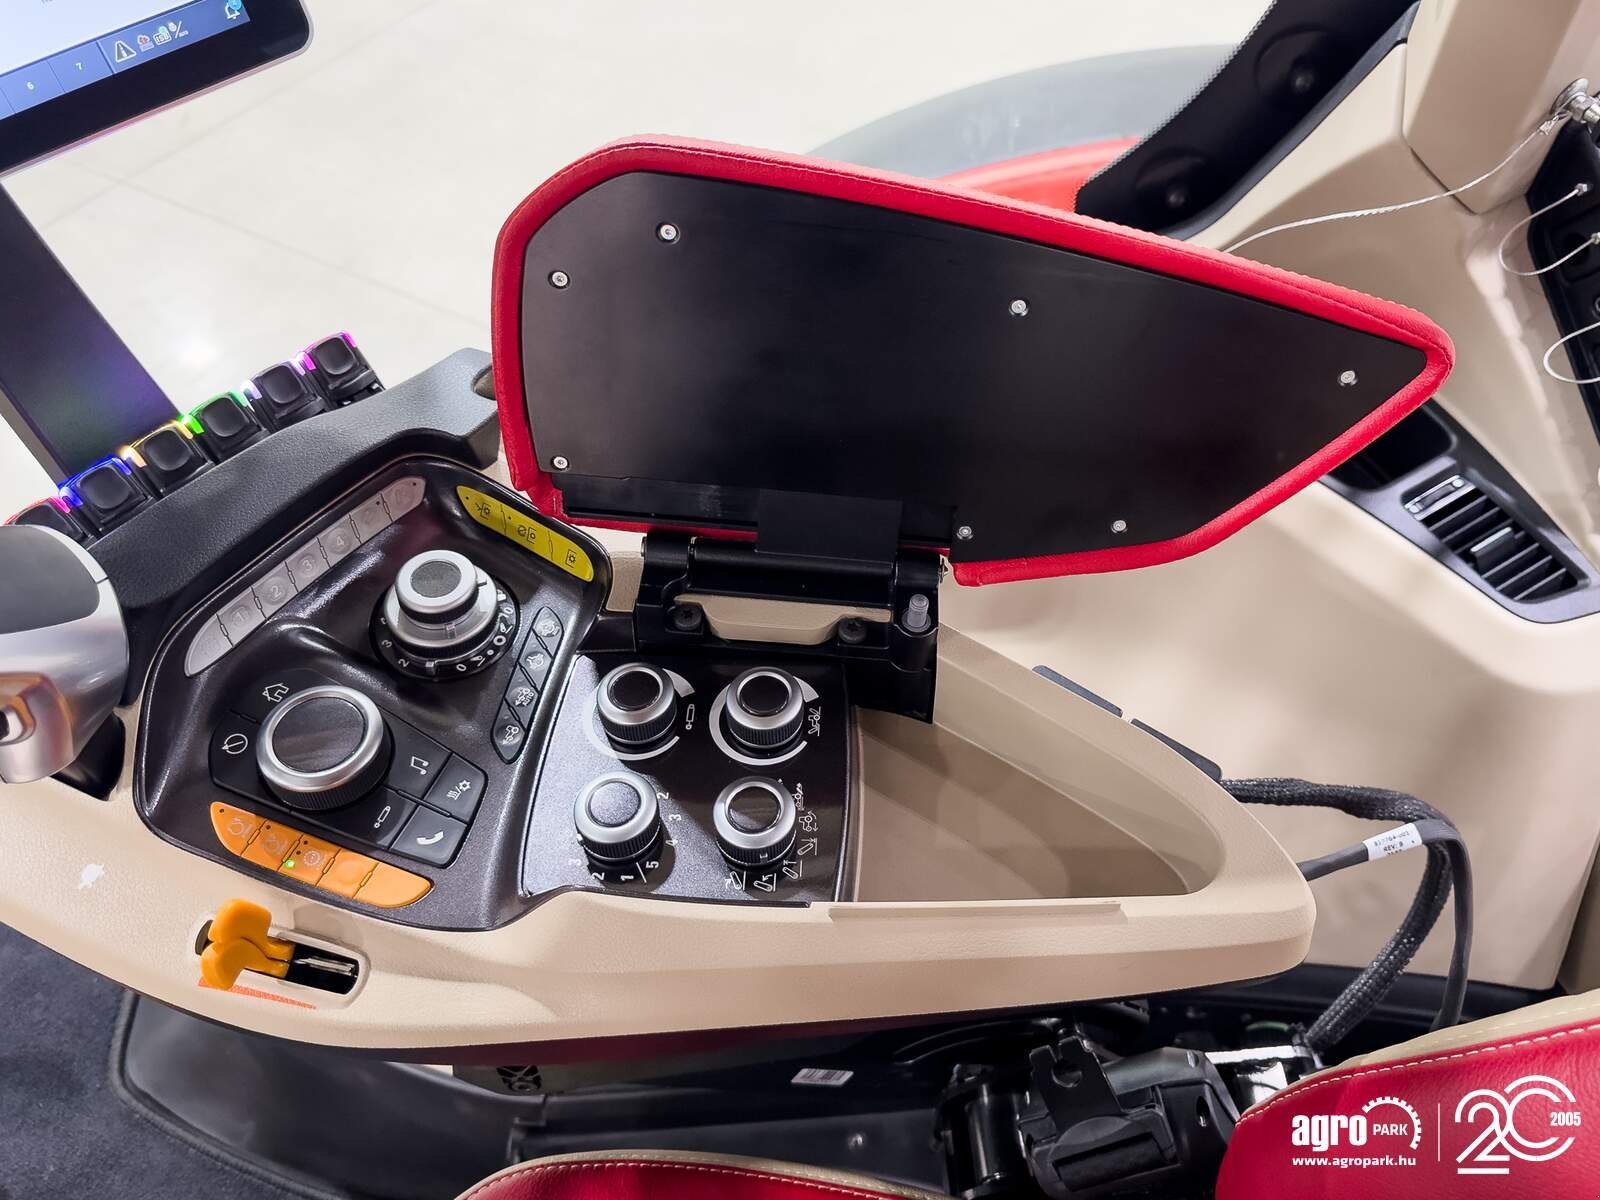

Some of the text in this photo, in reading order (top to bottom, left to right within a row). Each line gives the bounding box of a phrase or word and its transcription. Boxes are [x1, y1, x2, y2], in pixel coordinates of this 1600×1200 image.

[26, 62, 82, 91] 6 7
[270, 585, 281, 597] 2
[303, 560, 313, 572] 3
[335, 536, 345, 547] 4
[398, 658, 411, 668] 2
[656, 791, 670, 800] 2
[669, 813, 682, 821] 3
[665, 838, 678, 847] 4
[645, 860, 660, 869] 5
[591, 871, 606, 881] 2
